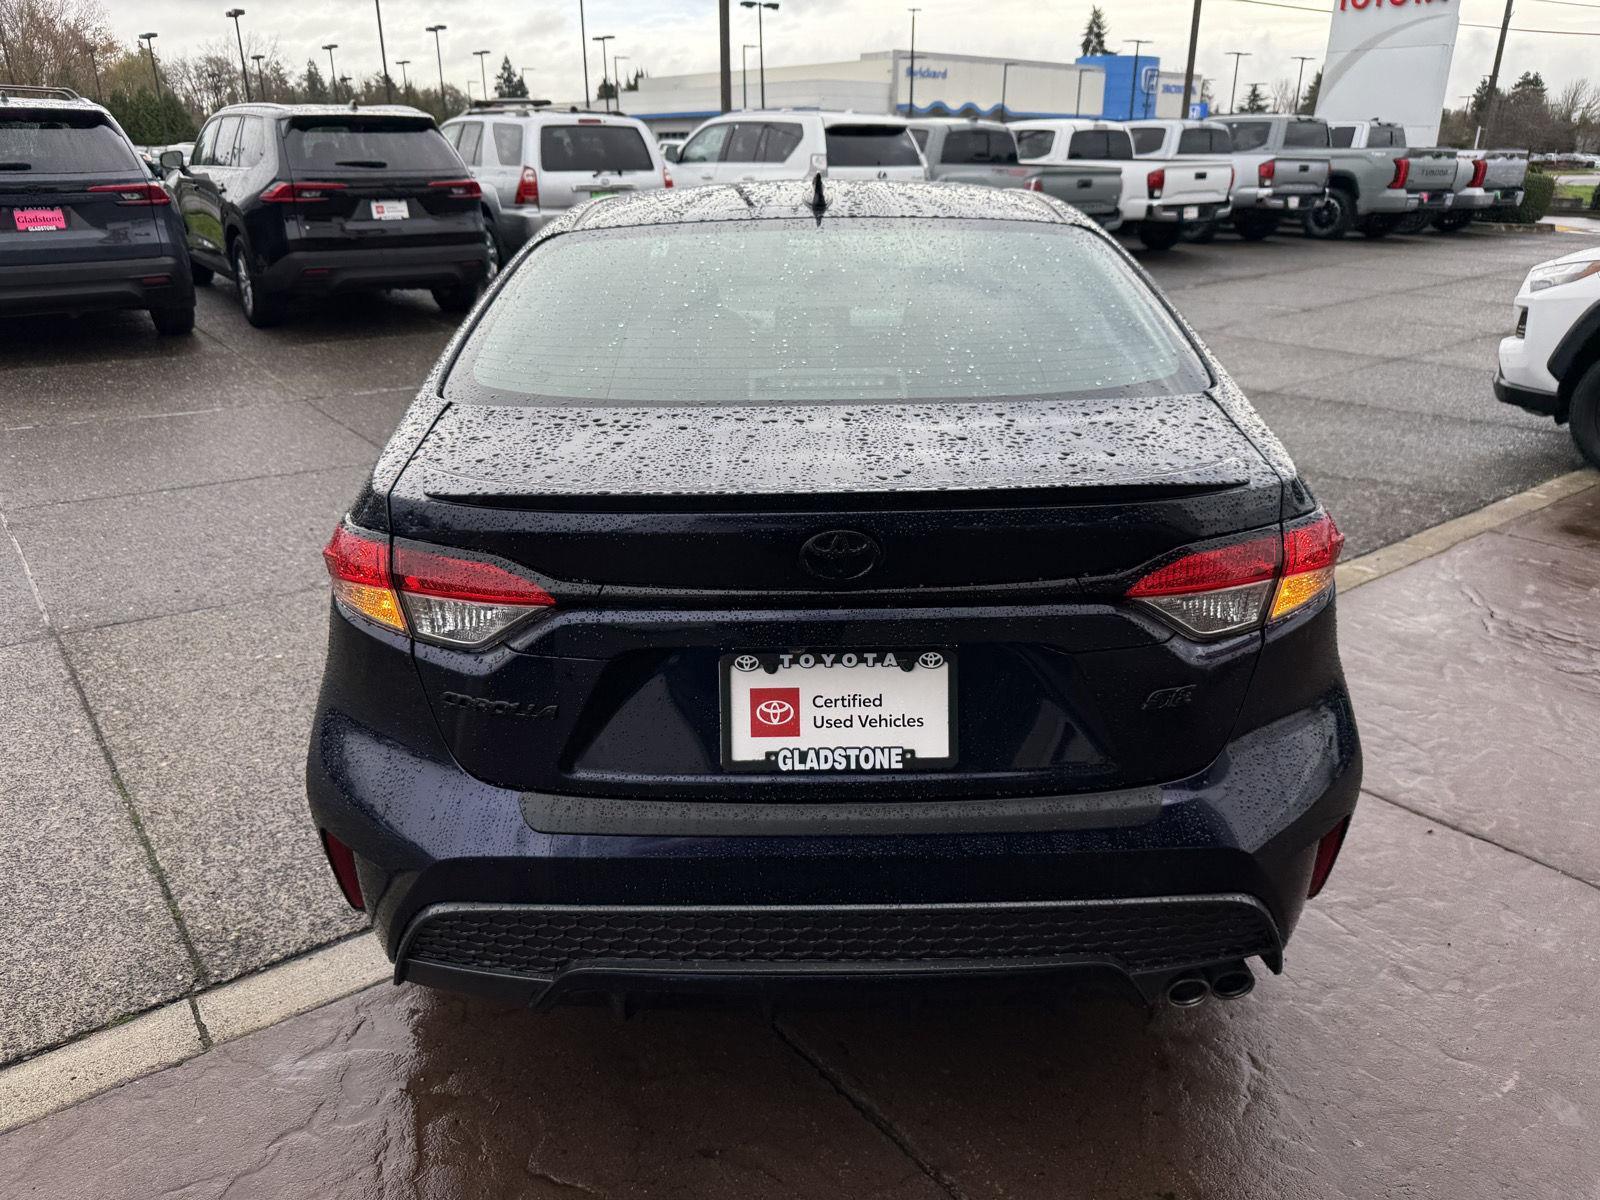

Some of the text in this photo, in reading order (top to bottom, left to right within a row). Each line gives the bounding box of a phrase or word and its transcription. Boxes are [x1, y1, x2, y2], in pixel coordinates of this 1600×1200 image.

[1162, 84, 1197, 95] HONA
[16, 215, 63, 224] Gladstone
[780, 652, 899, 668] TOYOTA
[812, 693, 883, 708] Certified
[812, 713, 925, 729] Used Vehicles
[777, 747, 903, 771] GLADSTONE
